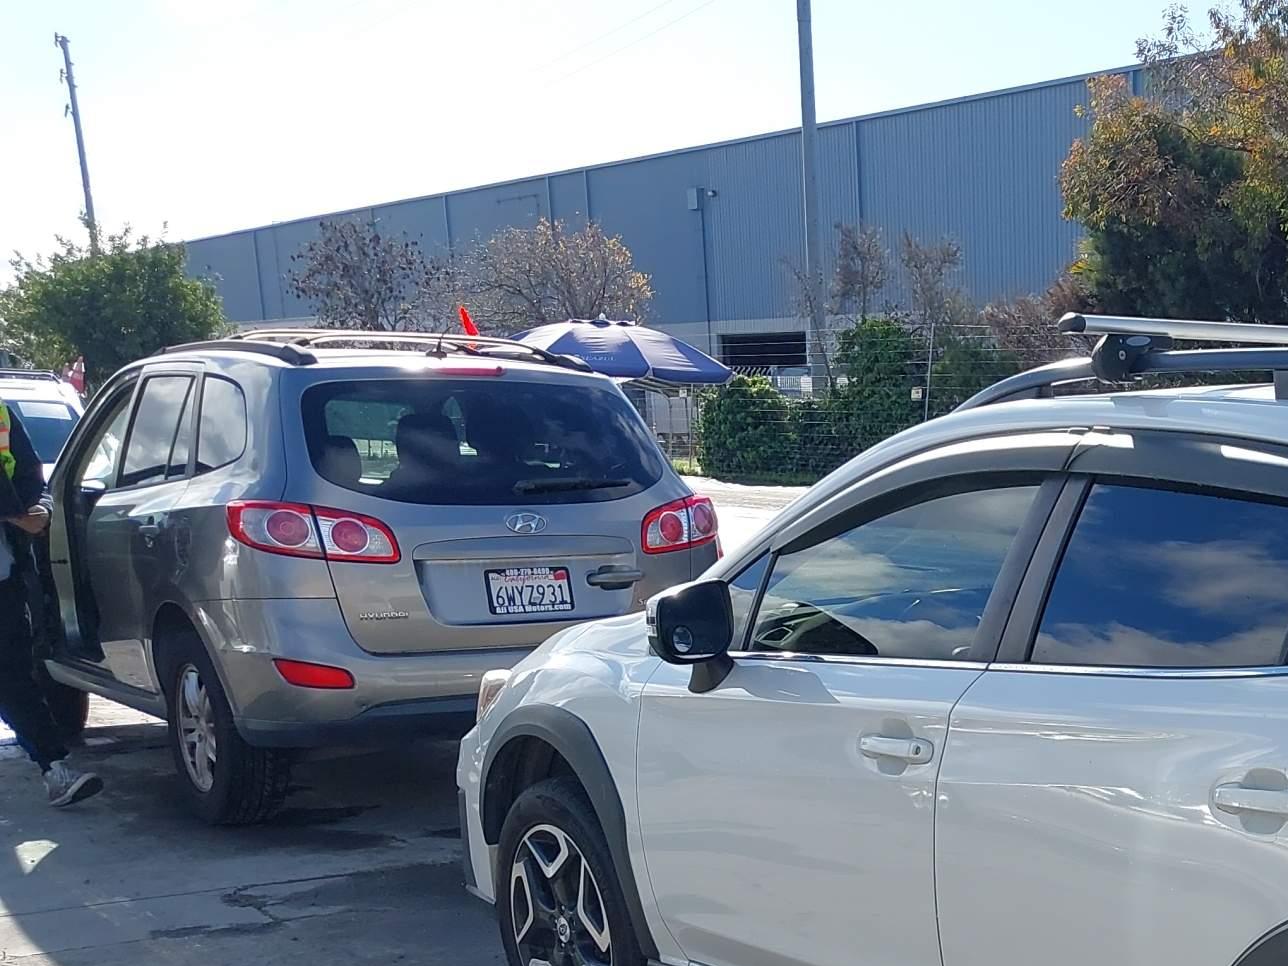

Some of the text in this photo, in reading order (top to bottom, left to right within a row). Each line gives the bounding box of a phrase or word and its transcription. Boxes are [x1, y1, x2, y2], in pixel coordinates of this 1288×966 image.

[496, 584, 568, 607] 6WYZ931
[508, 605, 524, 613] USA
[525, 604, 572, 612] Motors.com
[359, 611, 409, 620] HYUNDAI
